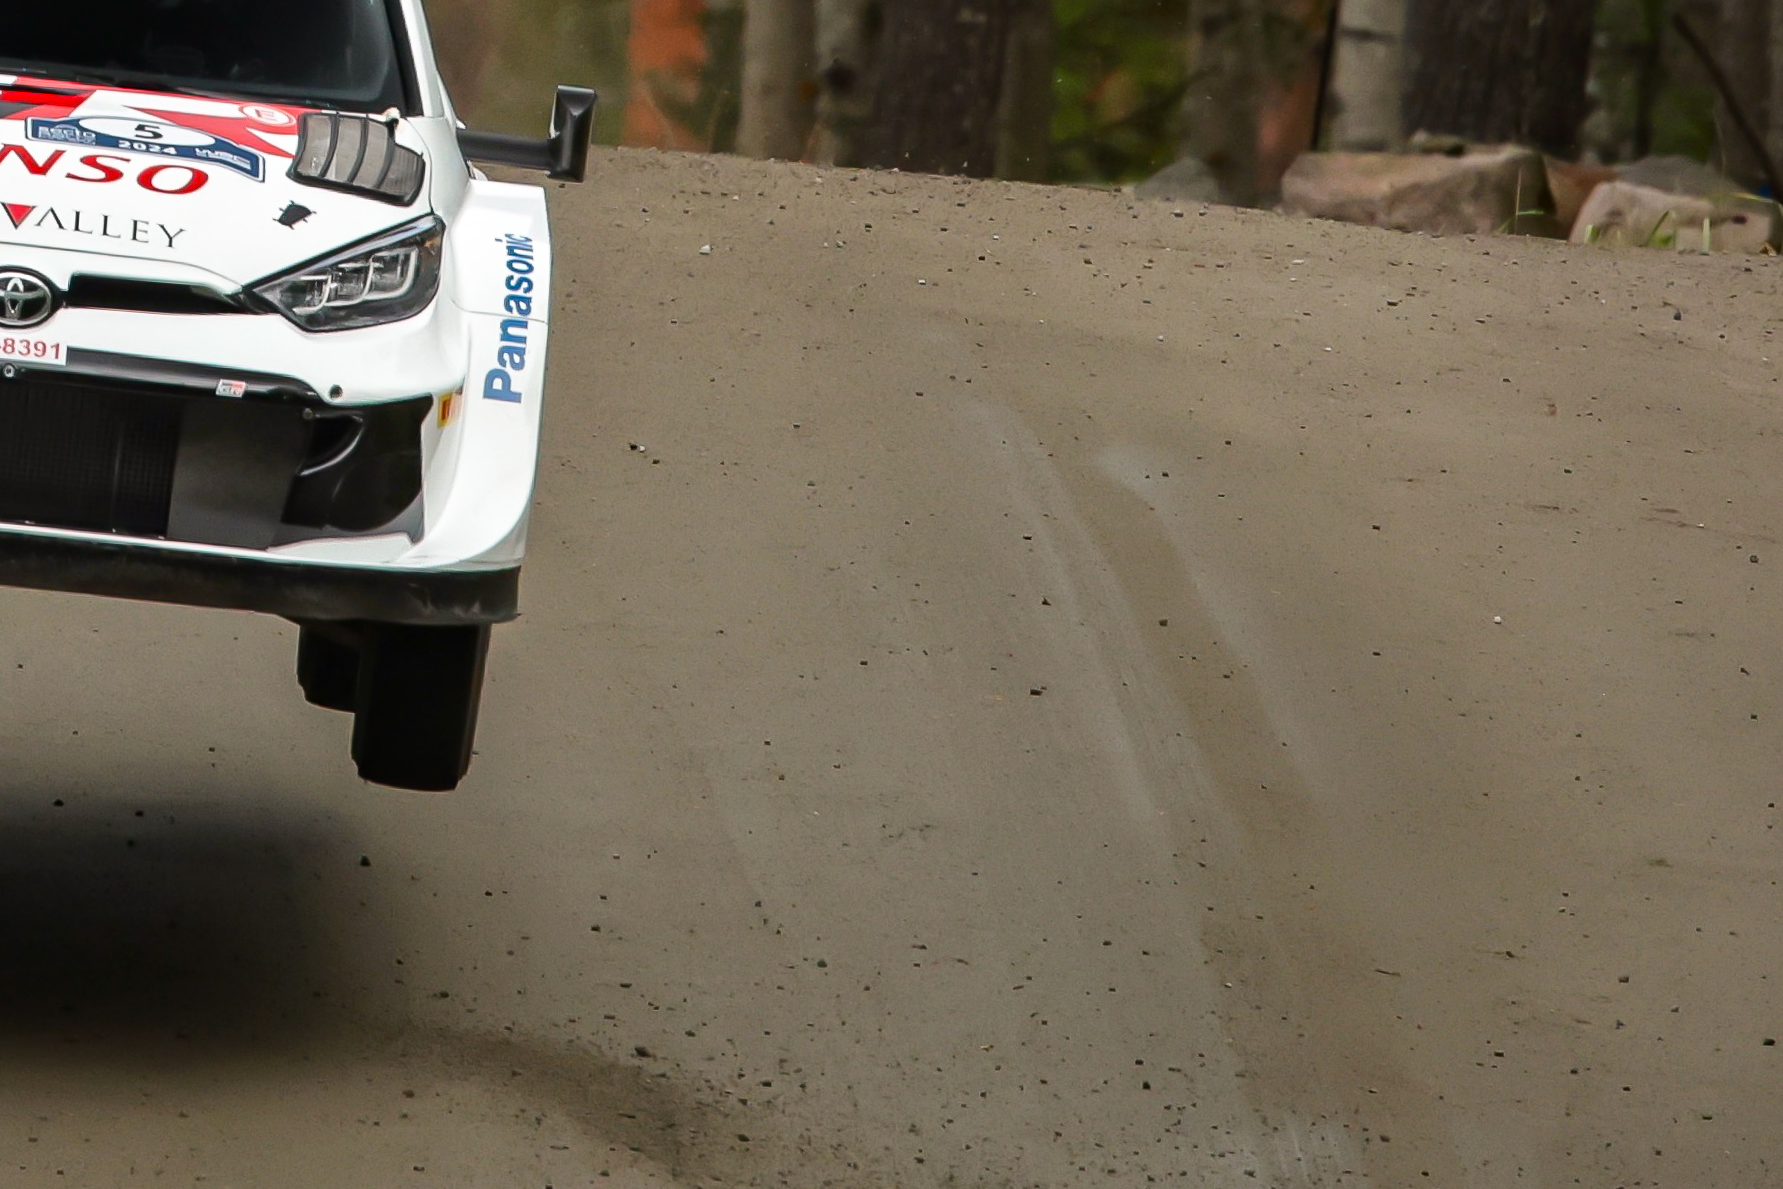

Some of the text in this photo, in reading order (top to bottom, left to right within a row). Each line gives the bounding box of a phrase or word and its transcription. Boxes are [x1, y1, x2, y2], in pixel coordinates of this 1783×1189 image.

[134, 123, 164, 140] 5
[118, 139, 178, 156] 2024
[482, 232, 535, 404] Panasonic
